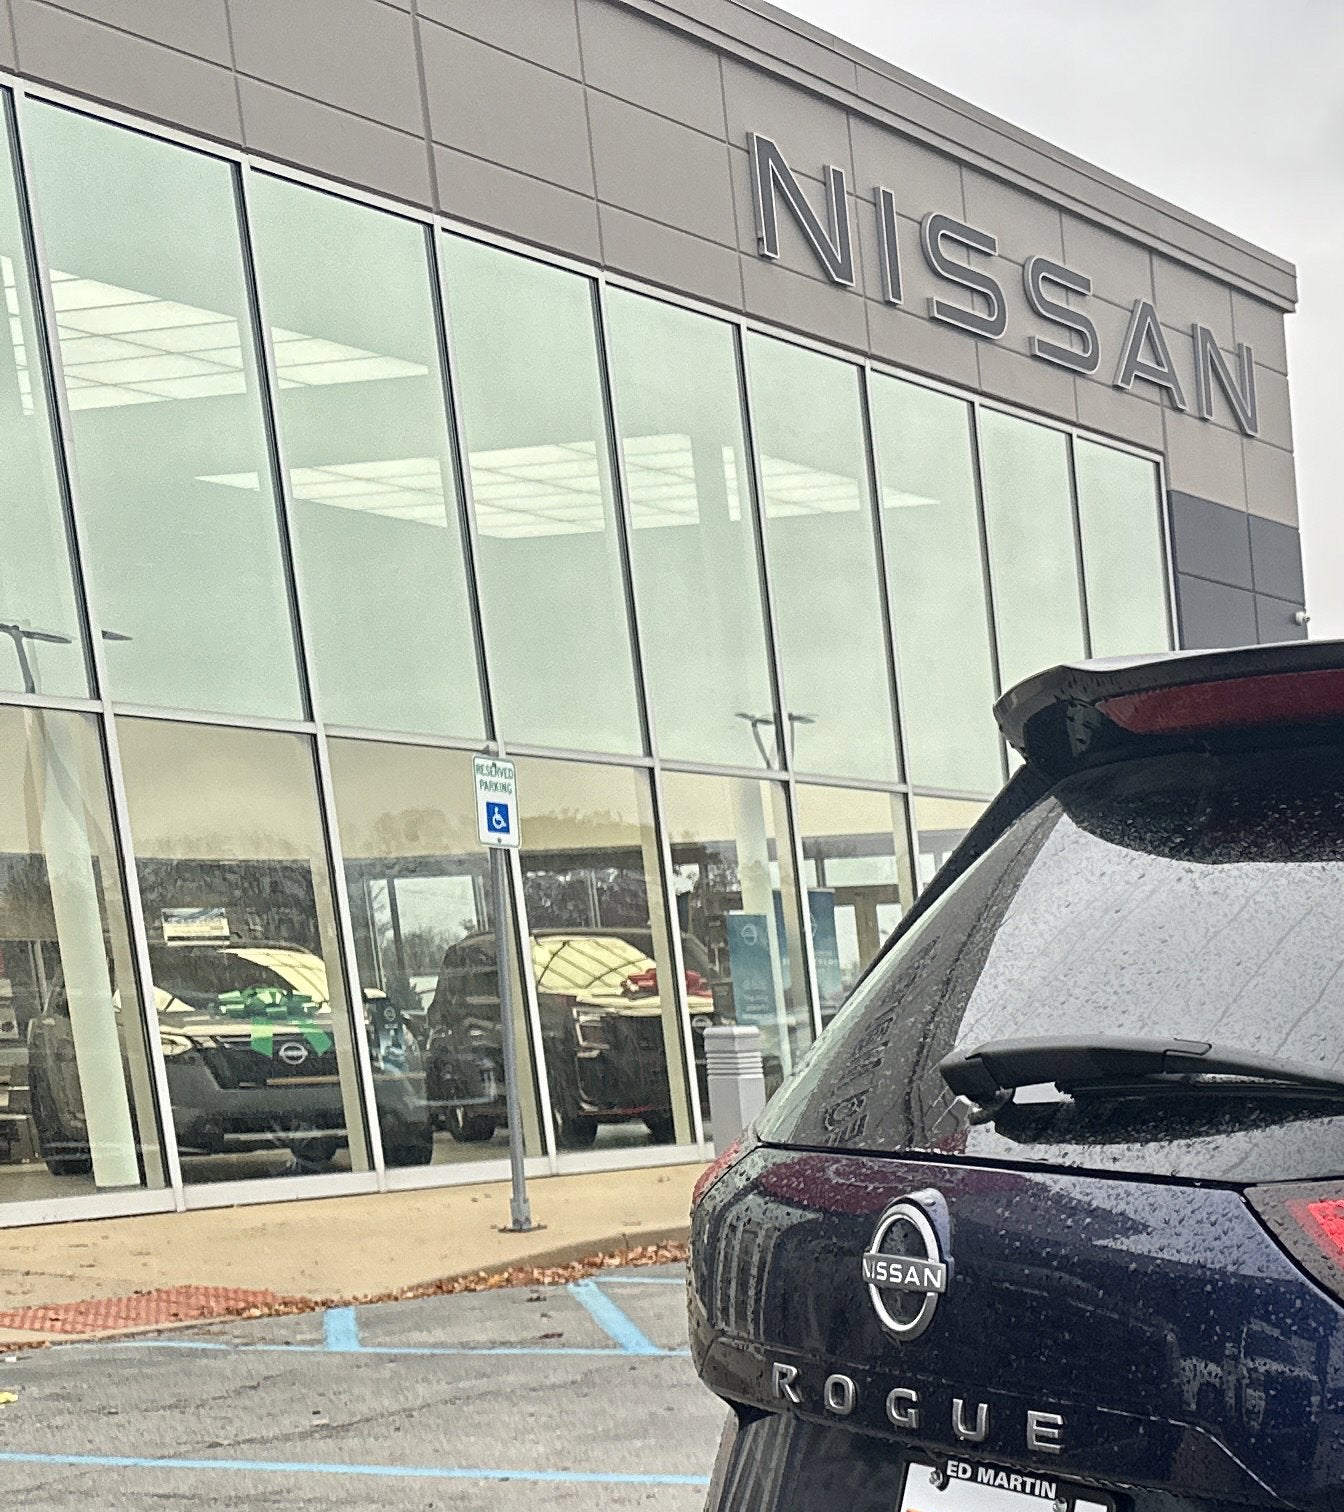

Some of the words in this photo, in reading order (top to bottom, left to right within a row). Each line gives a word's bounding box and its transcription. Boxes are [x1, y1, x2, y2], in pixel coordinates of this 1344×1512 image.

[747, 131, 1258, 437] NISSAN
[475, 763, 514, 780] RESERVED
[479, 779, 513, 795] PARKING
[863, 1256, 942, 1289] NISSAN
[771, 1361, 1066, 1455] ROGUE
[946, 1459, 973, 1481] ED
[977, 1467, 1058, 1500] MARTIN
